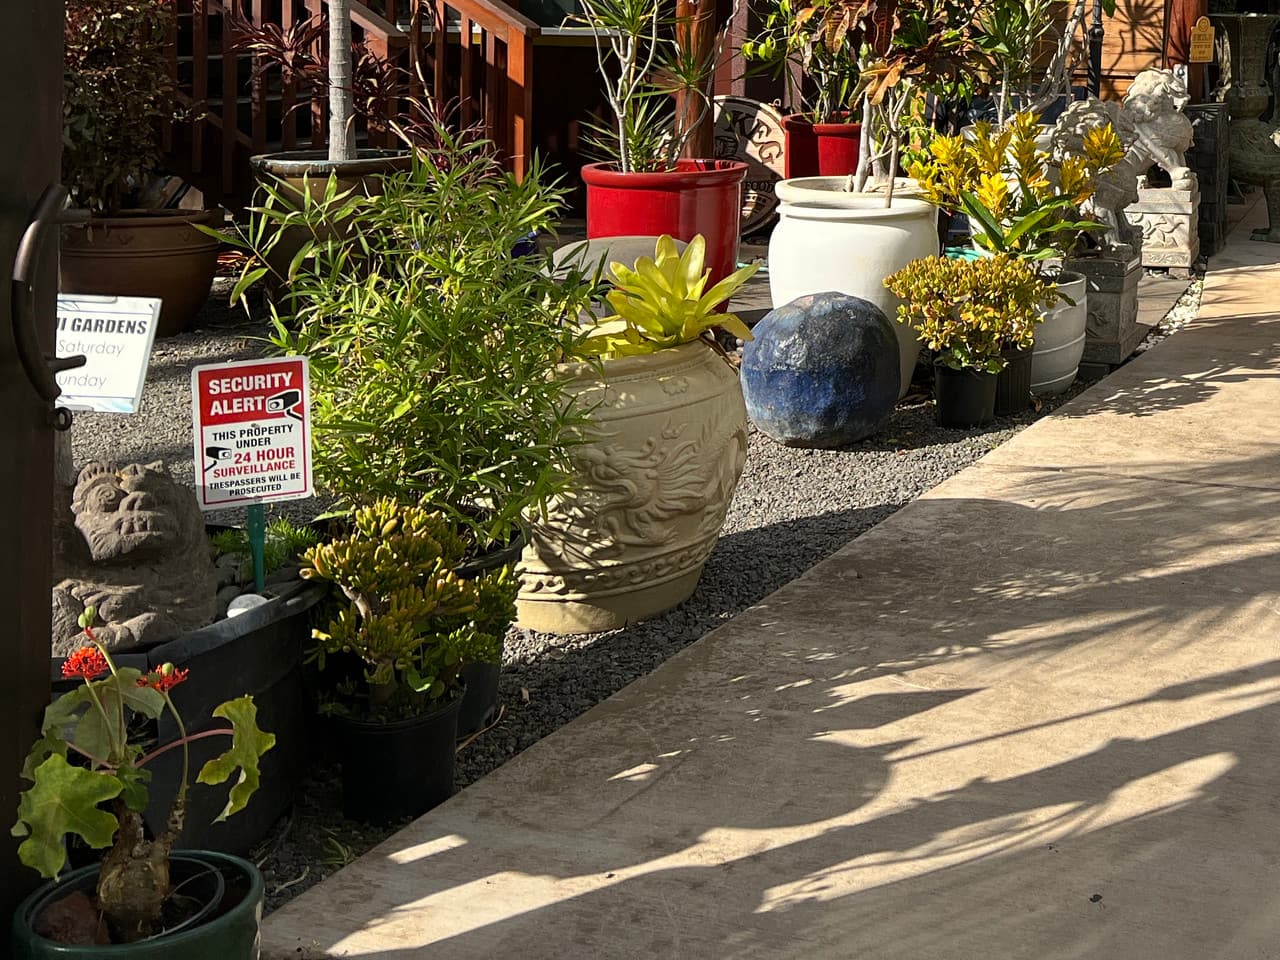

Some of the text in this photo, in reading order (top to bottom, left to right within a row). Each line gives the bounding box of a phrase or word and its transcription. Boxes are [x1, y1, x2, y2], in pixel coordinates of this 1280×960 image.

[71, 317, 148, 335] GARDENS
[57, 339, 126, 358] Saturday
[58, 373, 108, 389] unday
[208, 371, 293, 395] SECURITY
[210, 396, 265, 417] ALERT
[212, 424, 294, 441] THIS PROPERTY
[236, 437, 271, 449] UNDER
[234, 446, 295, 465] 24 HOUR
[213, 460, 296, 479] SURVEILLANCE
[209, 472, 301, 491] TRESPASSERS WILL BE
[229, 483, 282, 497] PROSECUTED
